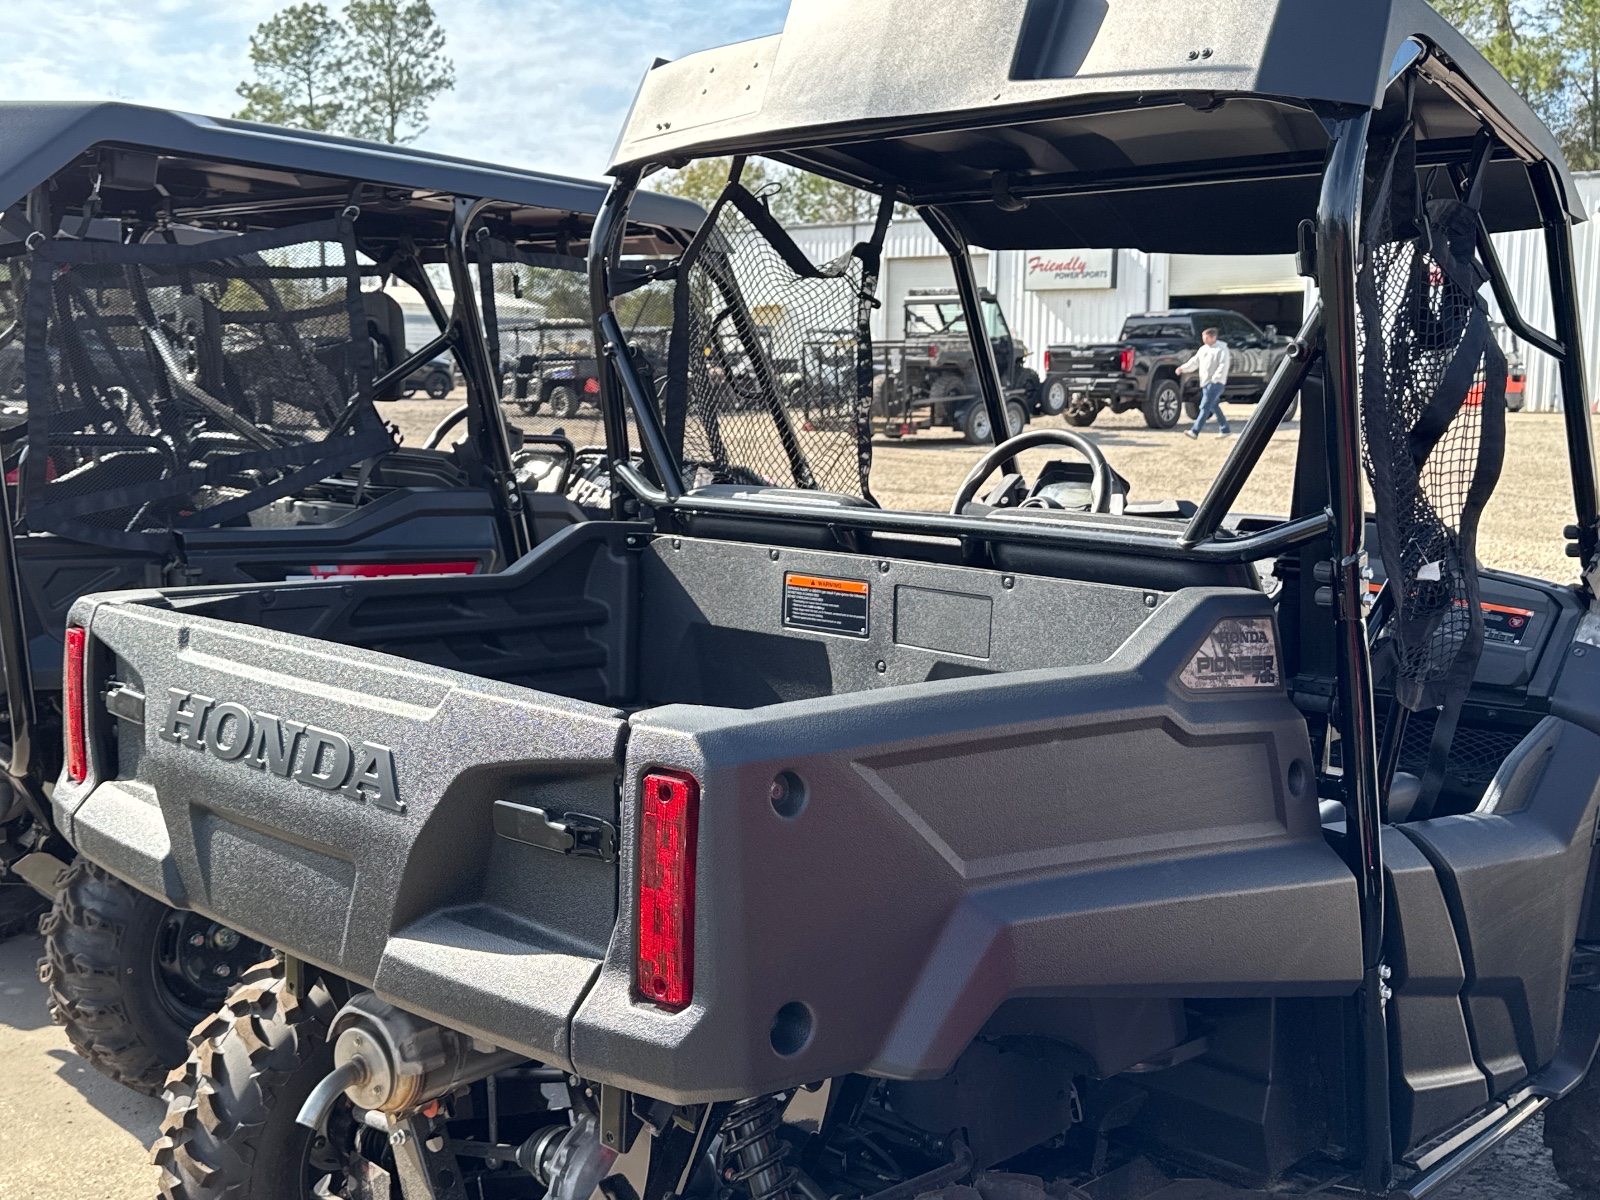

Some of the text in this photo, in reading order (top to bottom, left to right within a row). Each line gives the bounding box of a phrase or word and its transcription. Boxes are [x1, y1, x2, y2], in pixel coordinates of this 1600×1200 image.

[1028, 256, 1086, 275] Friendly
[1081, 271, 1107, 279] SPORTS
[1218, 631, 1269, 643] HONDA
[1197, 656, 1274, 673] PIONEER
[1252, 671, 1275, 683] 700
[159, 687, 407, 814] HONDA
